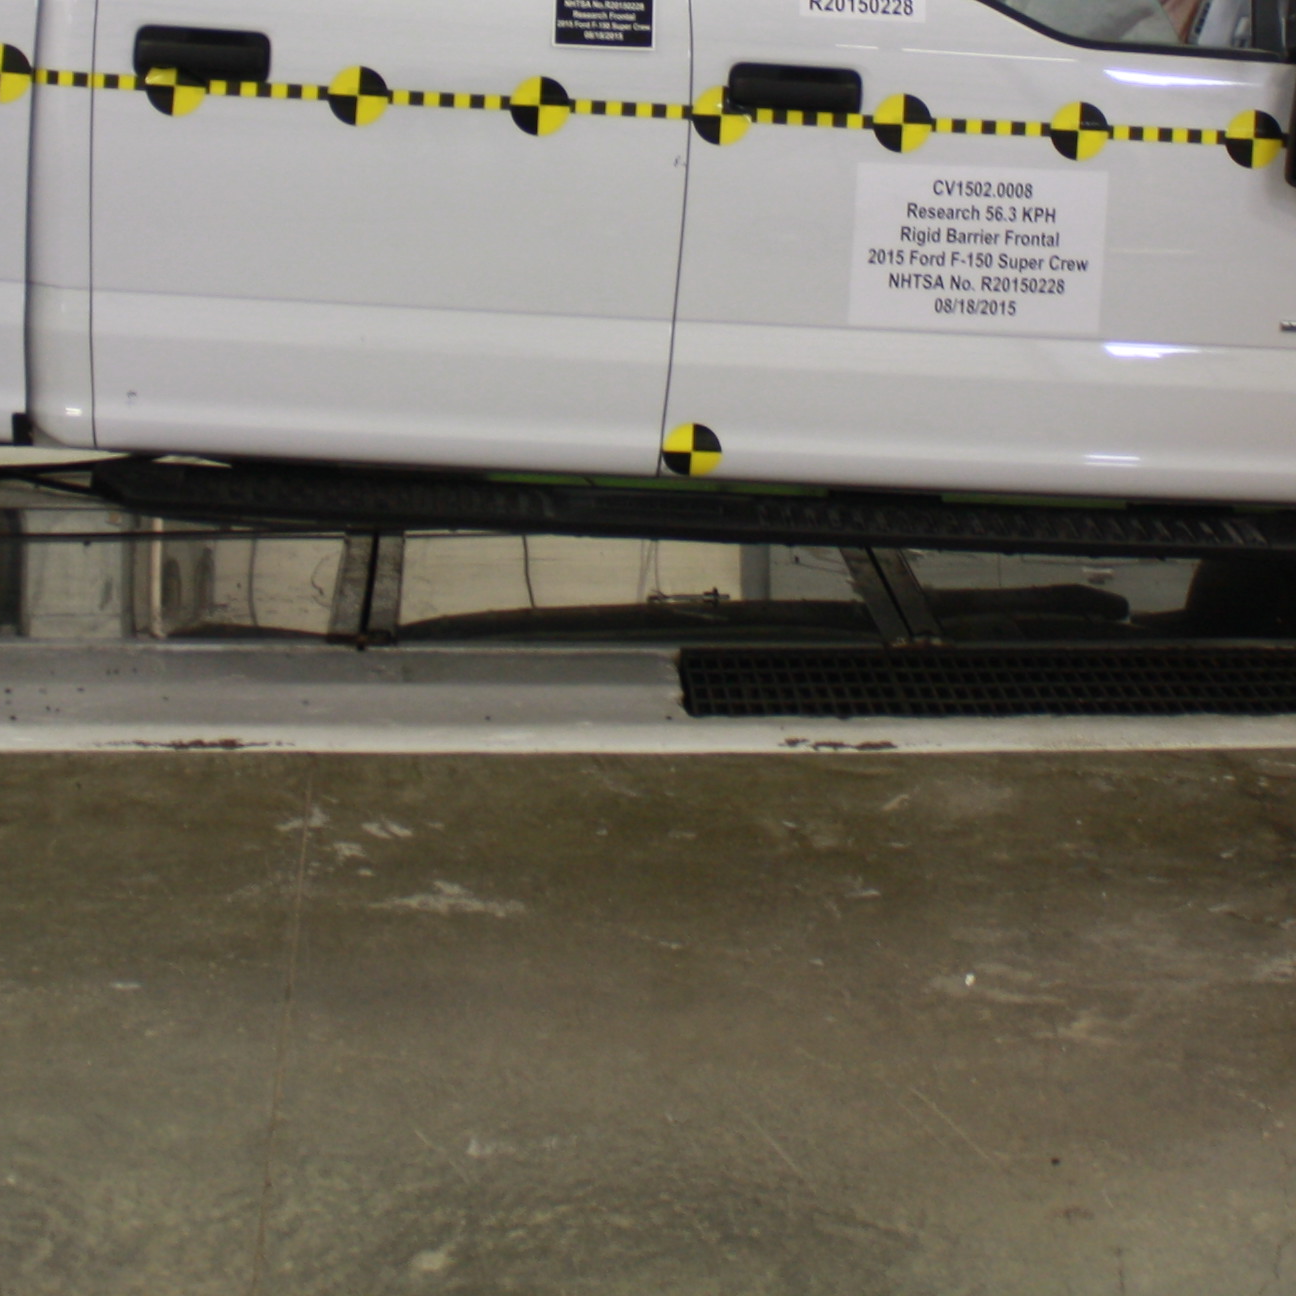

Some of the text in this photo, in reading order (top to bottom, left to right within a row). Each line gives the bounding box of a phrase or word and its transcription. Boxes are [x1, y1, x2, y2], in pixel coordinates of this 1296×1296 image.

[932, 179, 1033, 200] CV1502.0008
[906, 202, 1056, 224] Research 56.3 KPH
[900, 225, 1060, 247] Rigid Barrier Frontal
[867, 248, 1089, 273] 2015 Ford F-150 Super Crew
[888, 272, 1065, 295] NHTSA No. R20150228
[934, 297, 1017, 316] 08/18/2015
